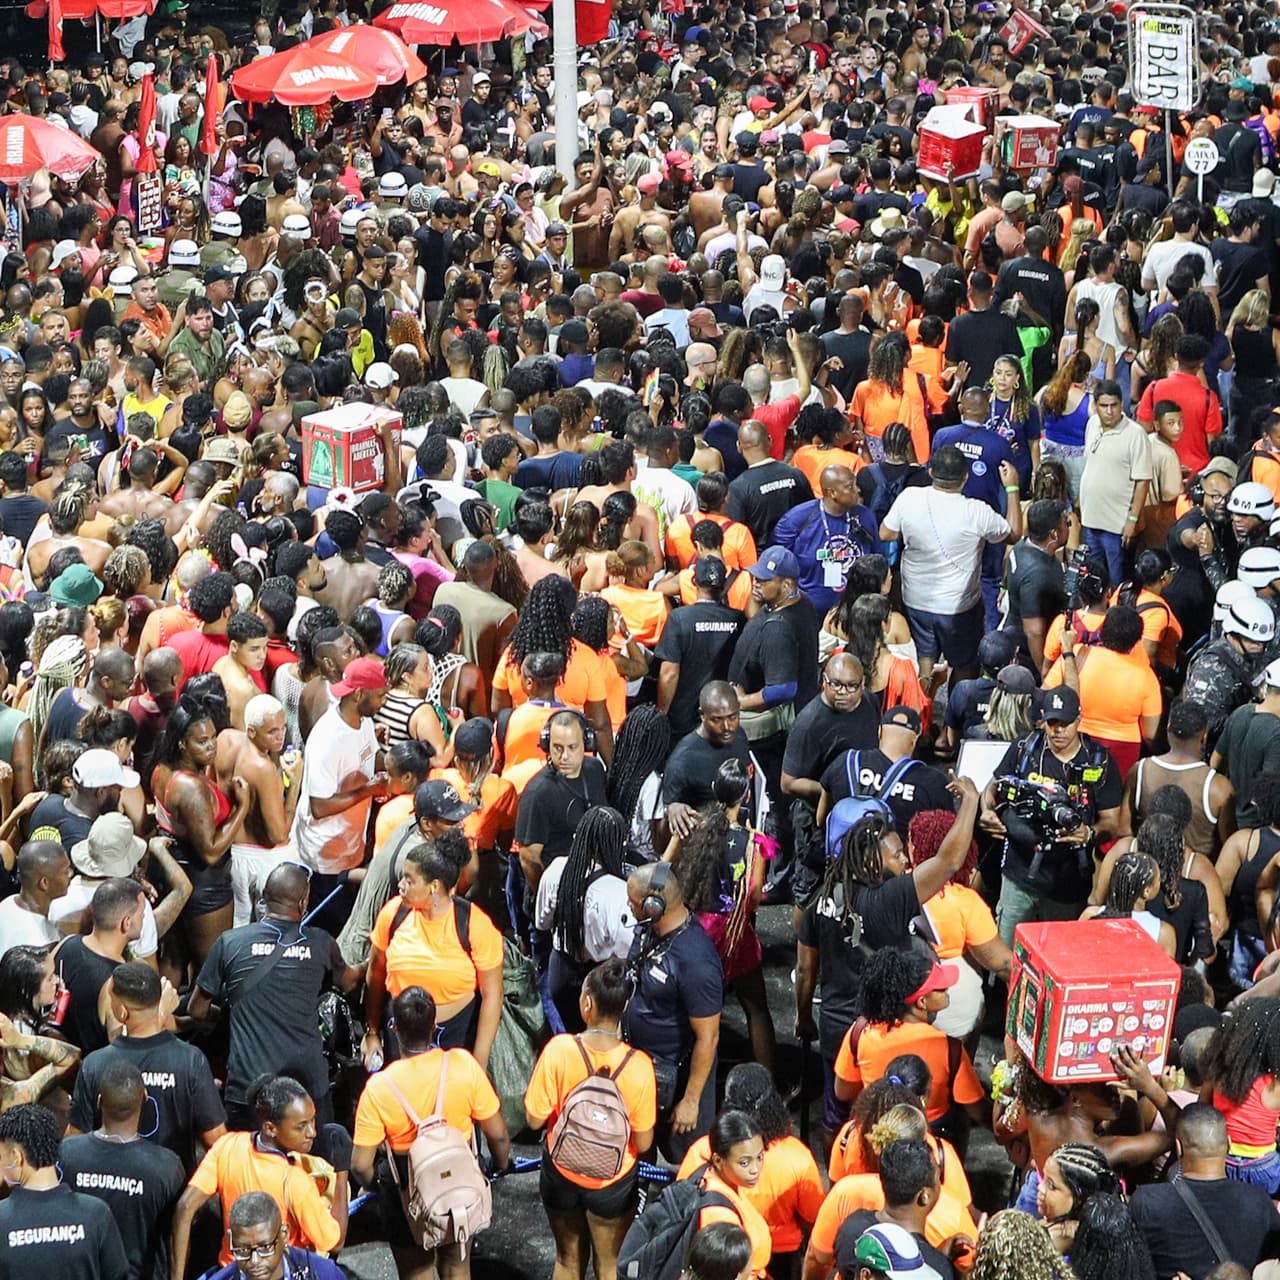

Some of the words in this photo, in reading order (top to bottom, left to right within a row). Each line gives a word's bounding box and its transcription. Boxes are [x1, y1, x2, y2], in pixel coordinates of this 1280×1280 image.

[387, 2, 448, 26] BRAHMA
[290, 64, 359, 87] BRAHMA
[1147, 43, 1179, 101] BAR
[6, 125, 26, 165] BRAHMA
[1187, 151, 1216, 160] CAIXA
[1194, 160, 1209, 171] 77
[760, 478, 796, 495] SEGURANÇA
[859, 768, 916, 801] QUPE
[251, 943, 312, 961] SEGANÇA
[1067, 1001, 1108, 1015] BRAHMA
[75, 1172, 145, 1197] SEGURANÇA
[8, 1224, 86, 1248] SEGURANÇA
